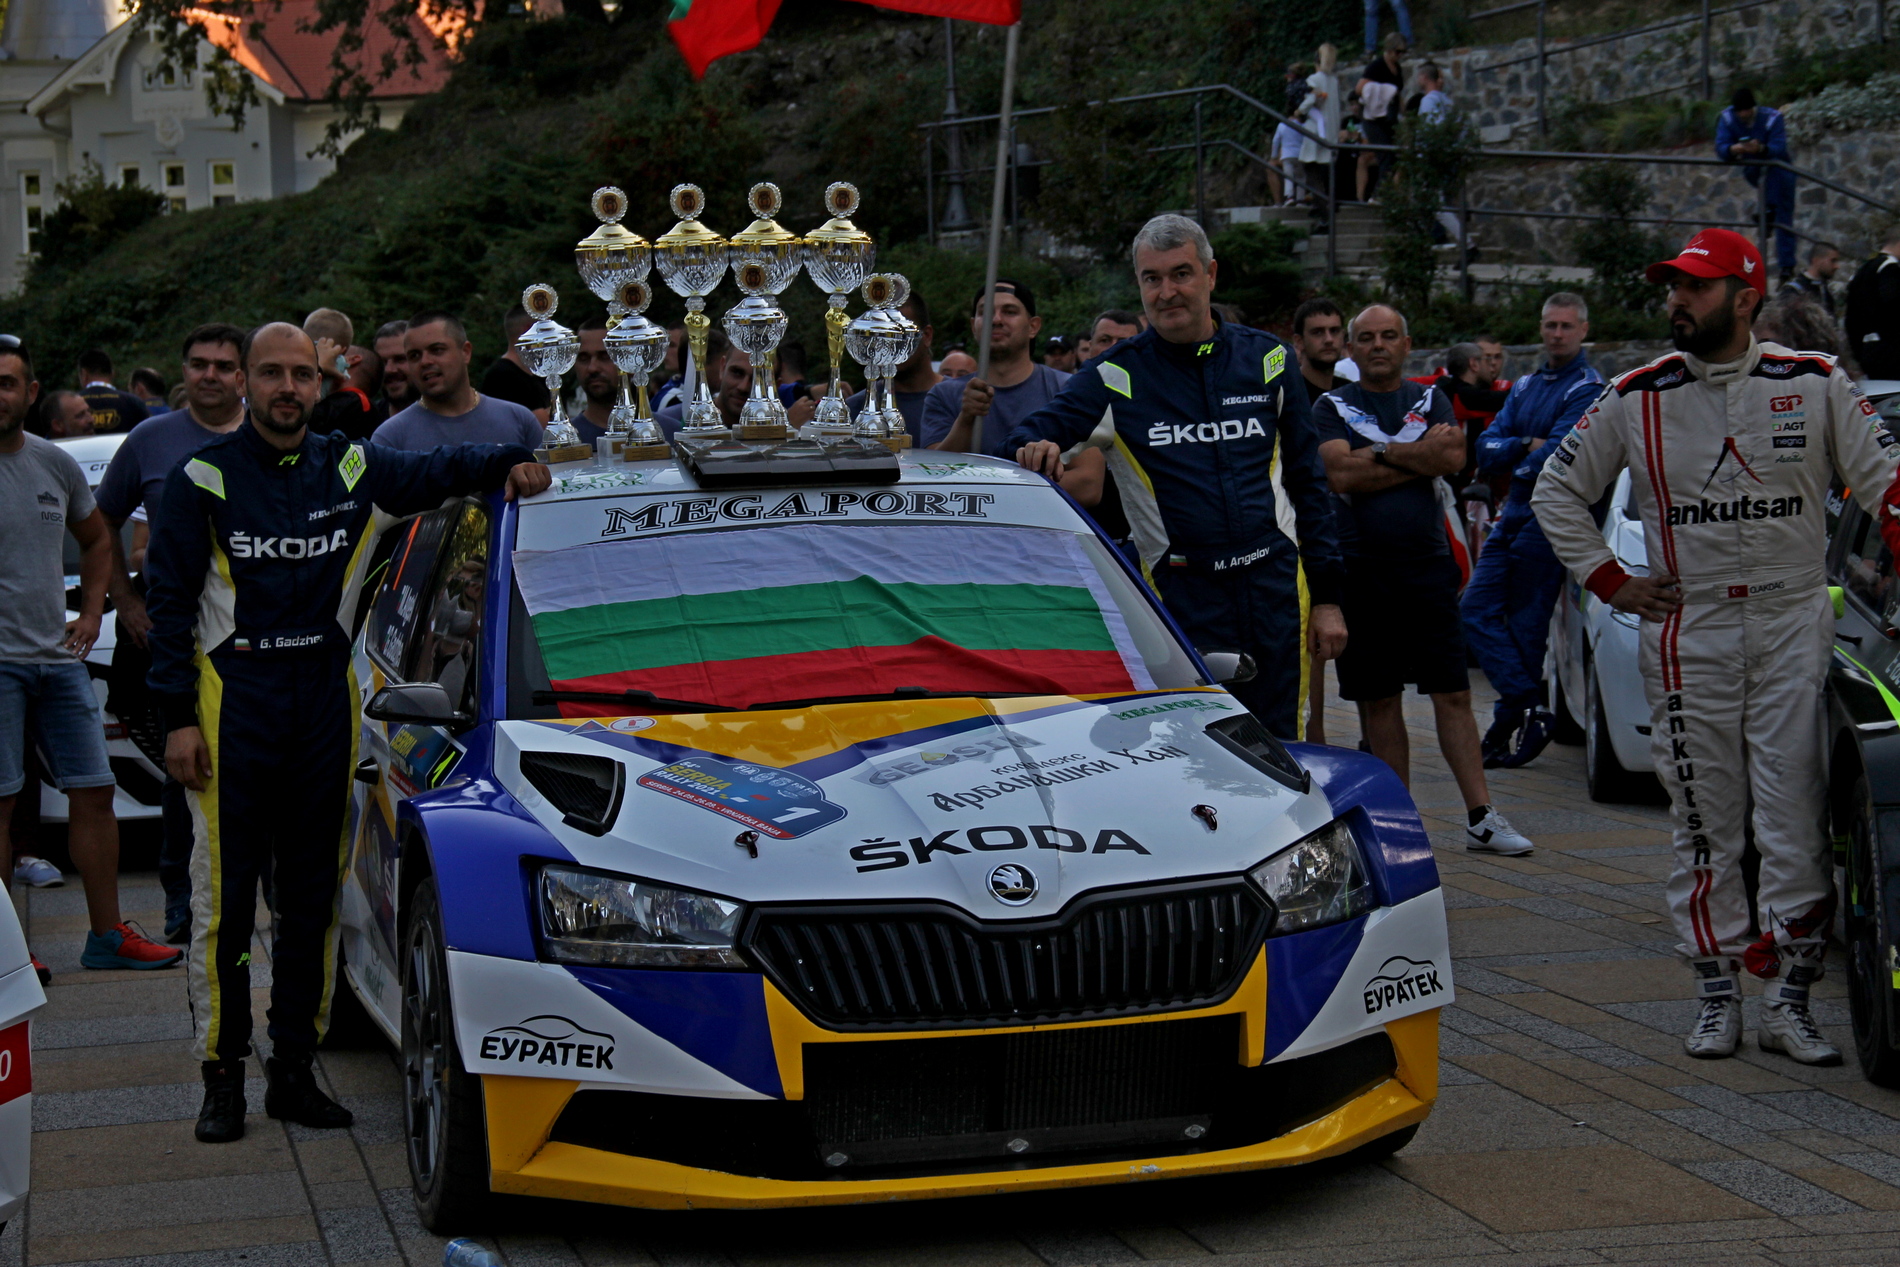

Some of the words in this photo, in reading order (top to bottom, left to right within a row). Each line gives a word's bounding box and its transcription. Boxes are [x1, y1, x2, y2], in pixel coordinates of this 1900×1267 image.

[1149, 418, 1266, 447] ŠKODA
[1783, 421, 1806, 431] AGT
[601, 491, 995, 537] MEGAPORT
[1666, 495, 1803, 526] ankutsan
[229, 529, 348, 560] ŠKODA
[1214, 560, 1227, 571] M.
[1230, 546, 1270, 568] Angelov
[260, 638, 272, 649] G.
[1110, 698, 1208, 721] MEGAPORT
[653, 770, 694, 784] RALLY
[687, 782, 721, 795] 2021
[663, 765, 733, 790] SERBIA
[736, 765, 757, 774] FIA
[927, 759, 1120, 812] Арбанашки
[1107, 745, 1190, 765] Хан
[1668, 694, 1711, 865] ankutsan
[772, 806, 820, 823] 1
[849, 825, 1152, 873] ŠKODA
[1363, 970, 1443, 1014] ЕУРАТЕК
[480, 1036, 614, 1070] ЕУРАТЕК
